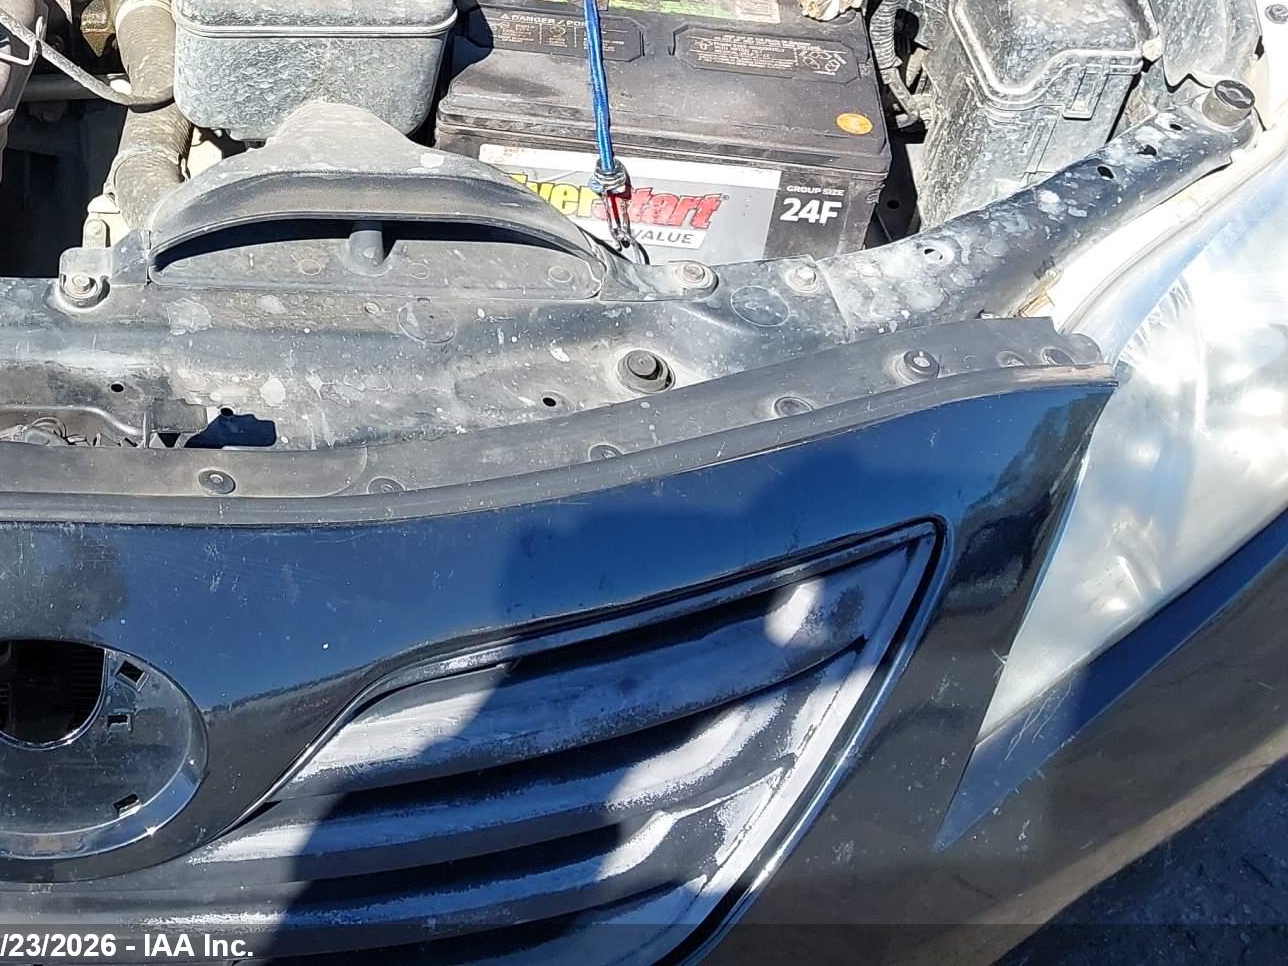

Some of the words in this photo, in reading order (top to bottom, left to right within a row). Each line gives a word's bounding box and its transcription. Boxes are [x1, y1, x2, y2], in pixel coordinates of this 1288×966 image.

[512, 14, 556, 25] DANGER
[786, 185, 821, 194] GROUP
[822, 188, 845, 196] SIZE
[779, 197, 842, 224] 24F
[630, 228, 694, 244] VALUE
